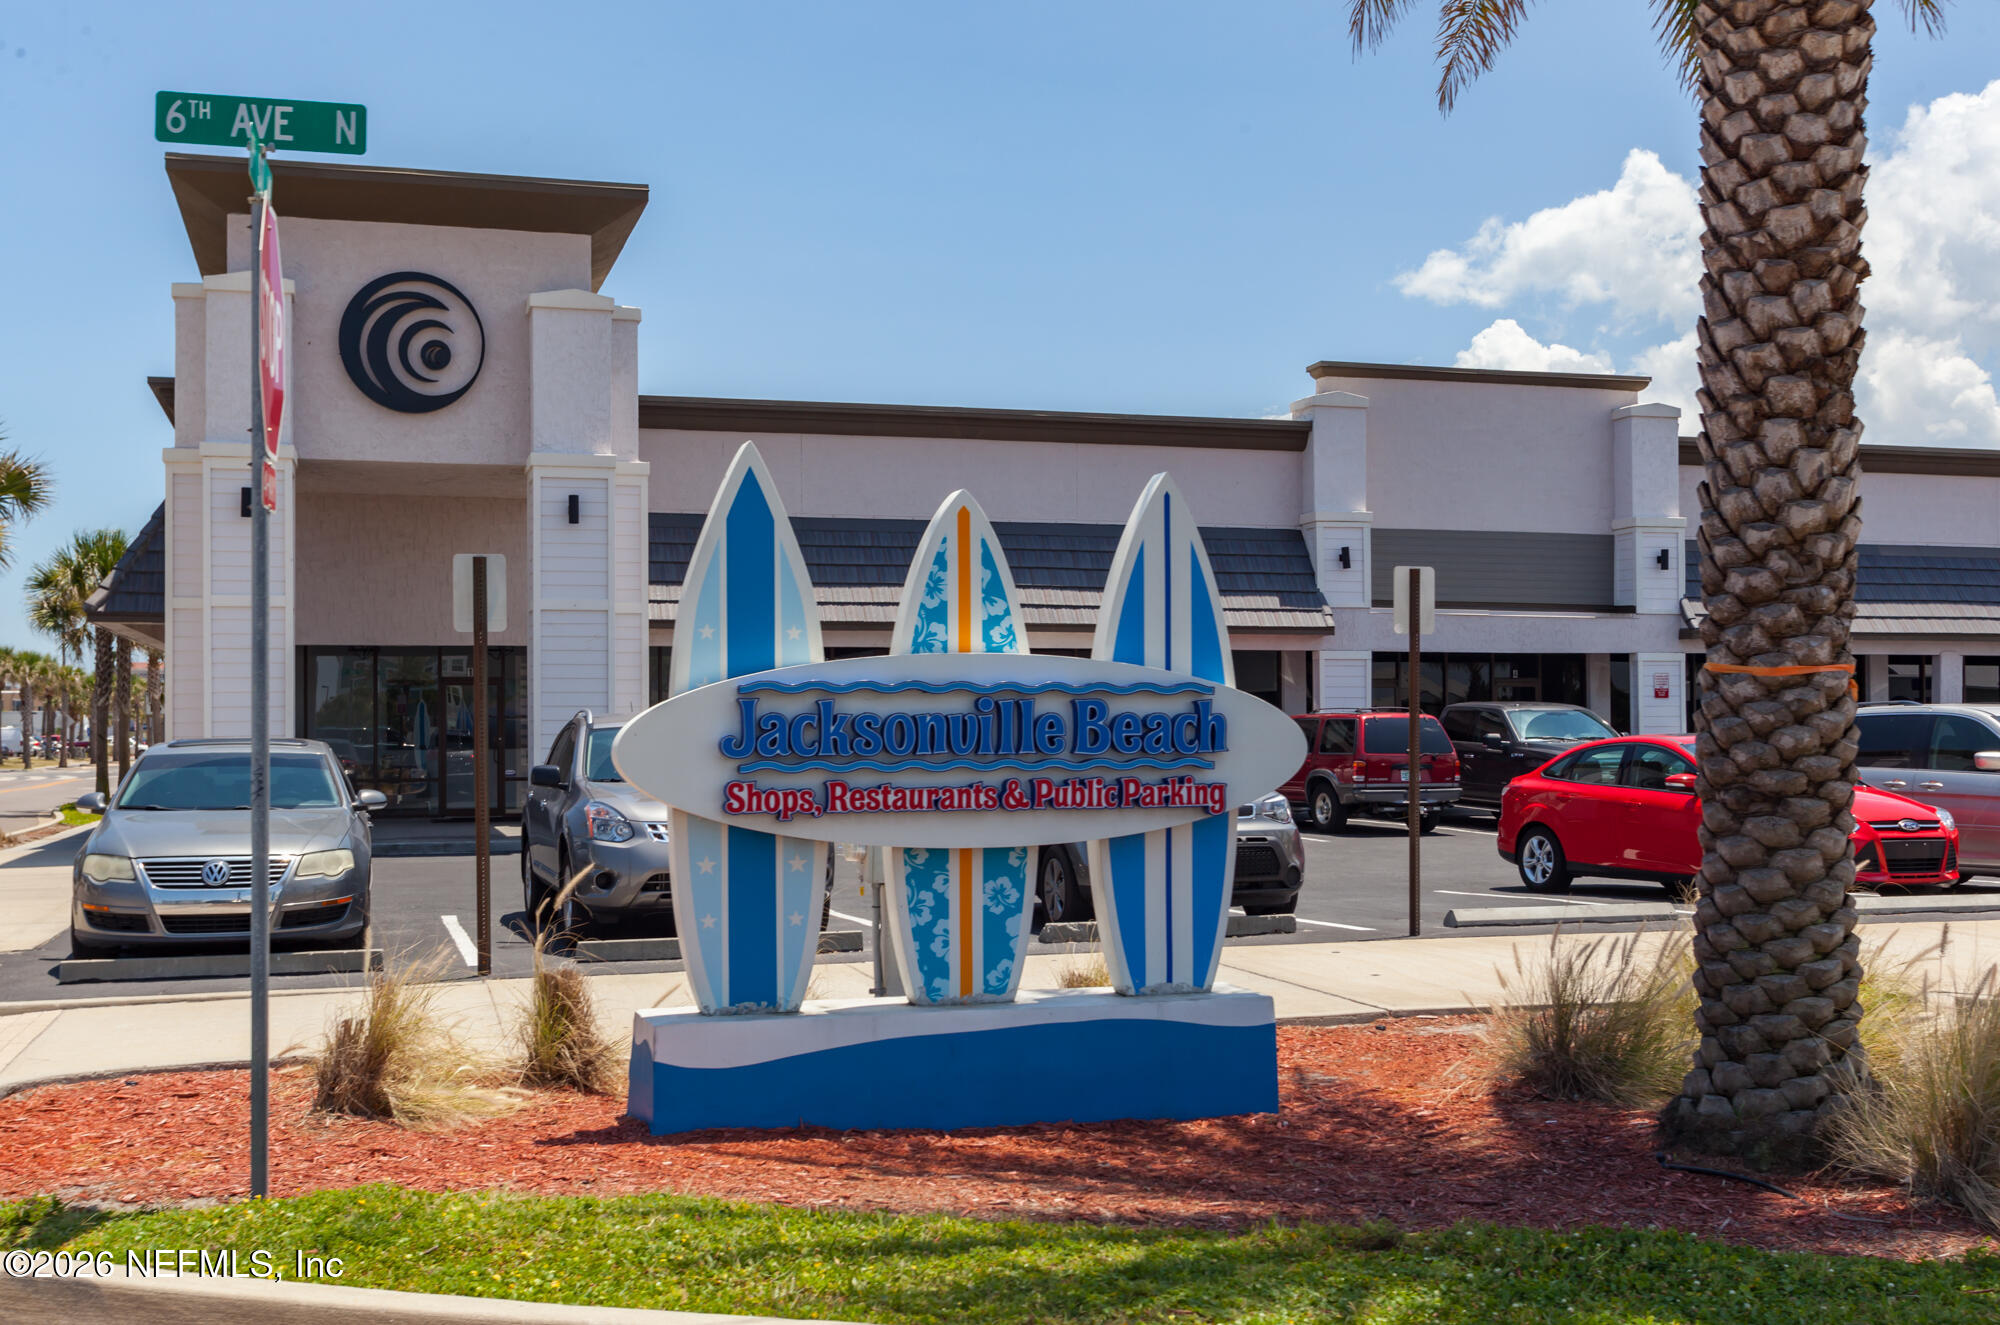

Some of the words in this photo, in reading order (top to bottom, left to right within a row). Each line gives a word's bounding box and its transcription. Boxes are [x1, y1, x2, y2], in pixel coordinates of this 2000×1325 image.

[165, 99, 211, 134] 6TH
[230, 102, 294, 142] AVE
[335, 109, 357, 146] N
[719, 696, 1067, 759] Jacksonville
[1070, 698, 1229, 756] Beach
[724, 780, 825, 822] Shops,
[825, 780, 999, 814] Restaurants
[1000, 777, 1030, 812] &
[1030, 775, 1120, 811] Public
[1119, 773, 1227, 816] Parking
